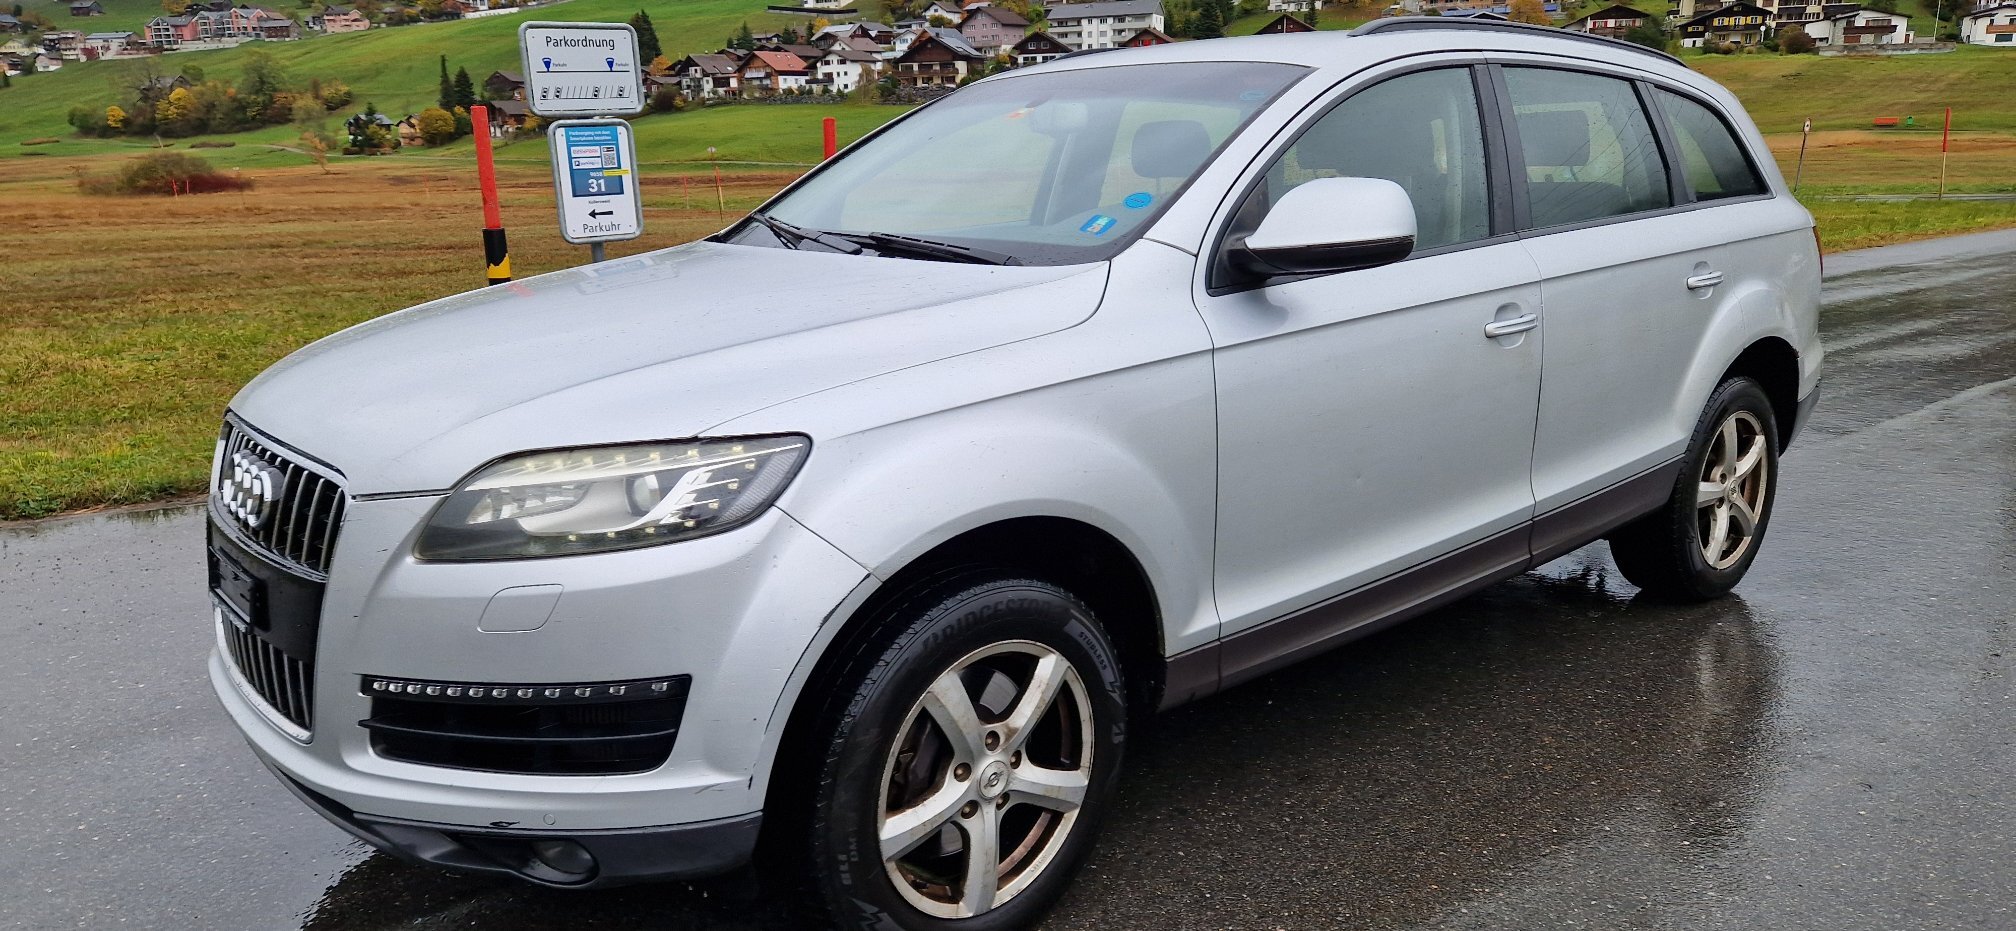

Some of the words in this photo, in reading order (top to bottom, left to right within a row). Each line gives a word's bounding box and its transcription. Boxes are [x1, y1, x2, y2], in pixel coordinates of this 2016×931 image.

[545, 35, 615, 51] Parkordnung
[588, 179, 606, 193] 31
[582, 221, 621, 234] Parkuhr
[1078, 631, 1108, 671] STUDLESS
